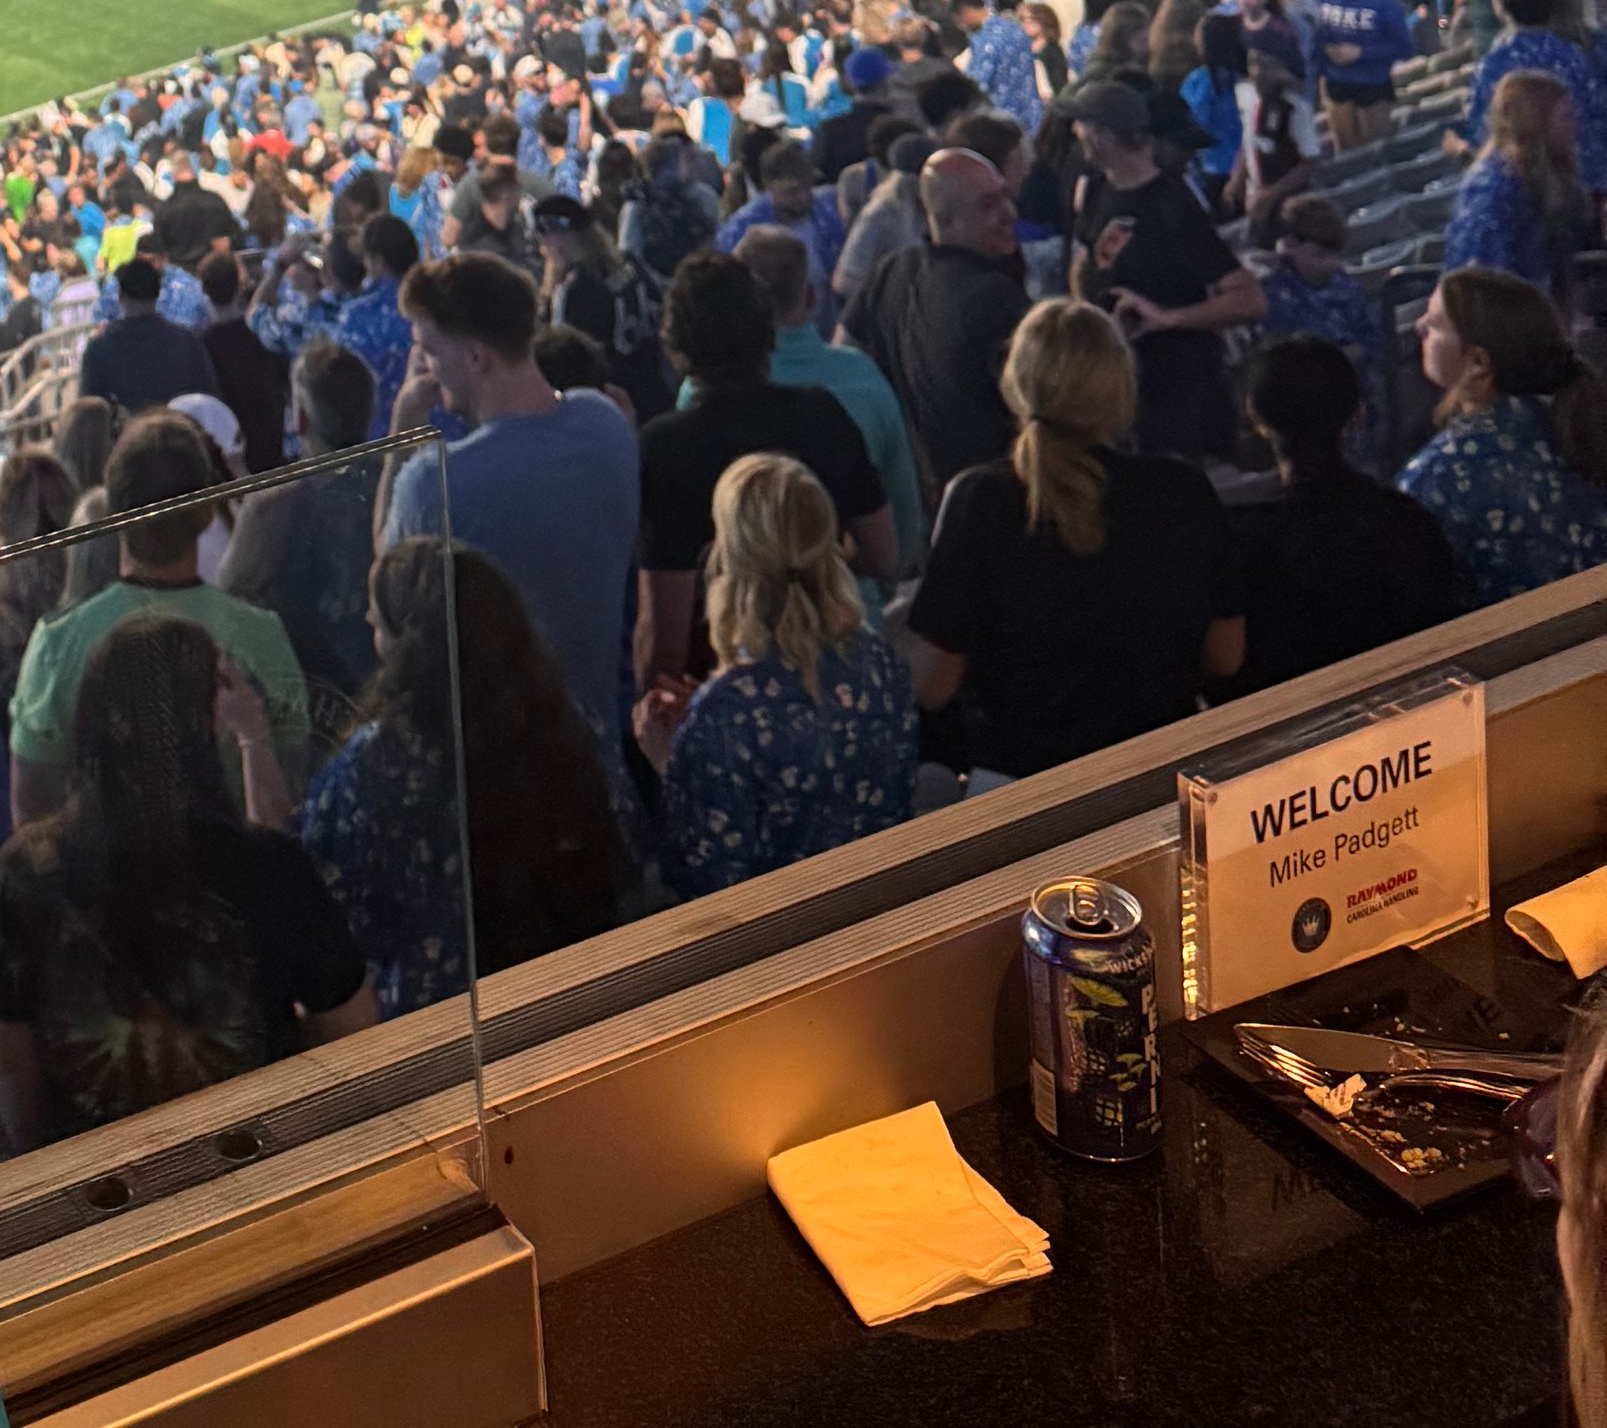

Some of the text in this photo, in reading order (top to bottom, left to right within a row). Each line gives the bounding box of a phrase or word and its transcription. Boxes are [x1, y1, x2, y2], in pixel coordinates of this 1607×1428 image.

[1250, 741, 1432, 844] WELCOME
[1269, 805, 1419, 887] Mike Padgett
[1346, 868, 1418, 909] RAYMOND
[1346, 901, 1384, 924] CAROLINA
[1383, 886, 1419, 908] HANDLING
